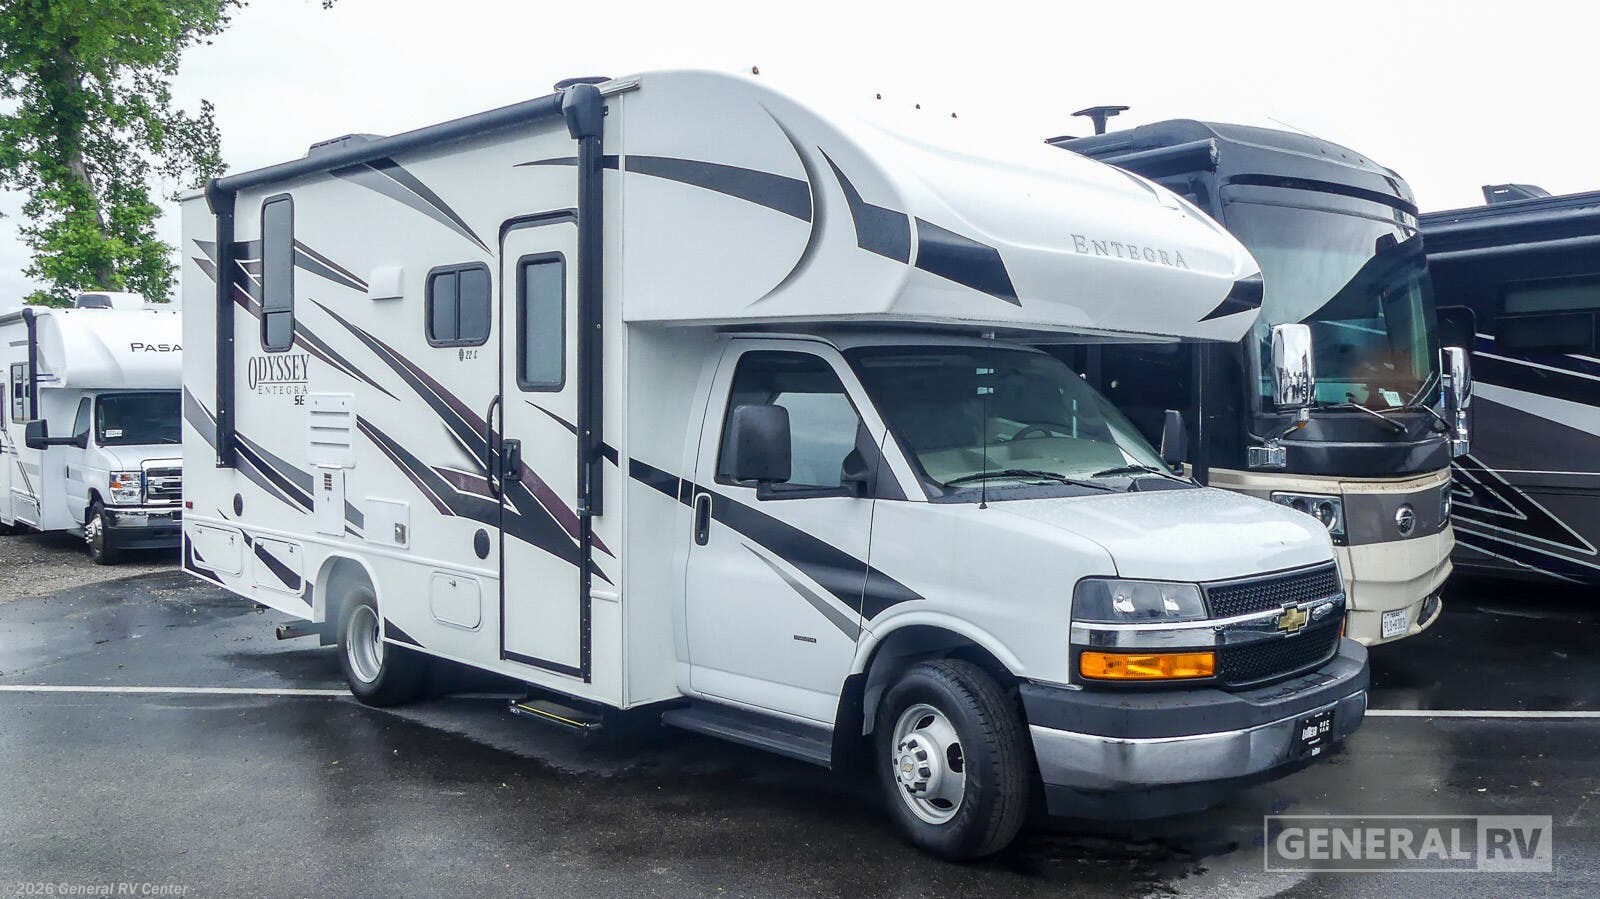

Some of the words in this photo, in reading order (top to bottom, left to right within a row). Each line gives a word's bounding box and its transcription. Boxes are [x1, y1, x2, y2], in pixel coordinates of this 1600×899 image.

[1070, 233, 1190, 270] ENTEGRA
[248, 354, 310, 391] ODYSSEY
[258, 385, 308, 395] ENTEGRA
[294, 395, 305, 405] SE
